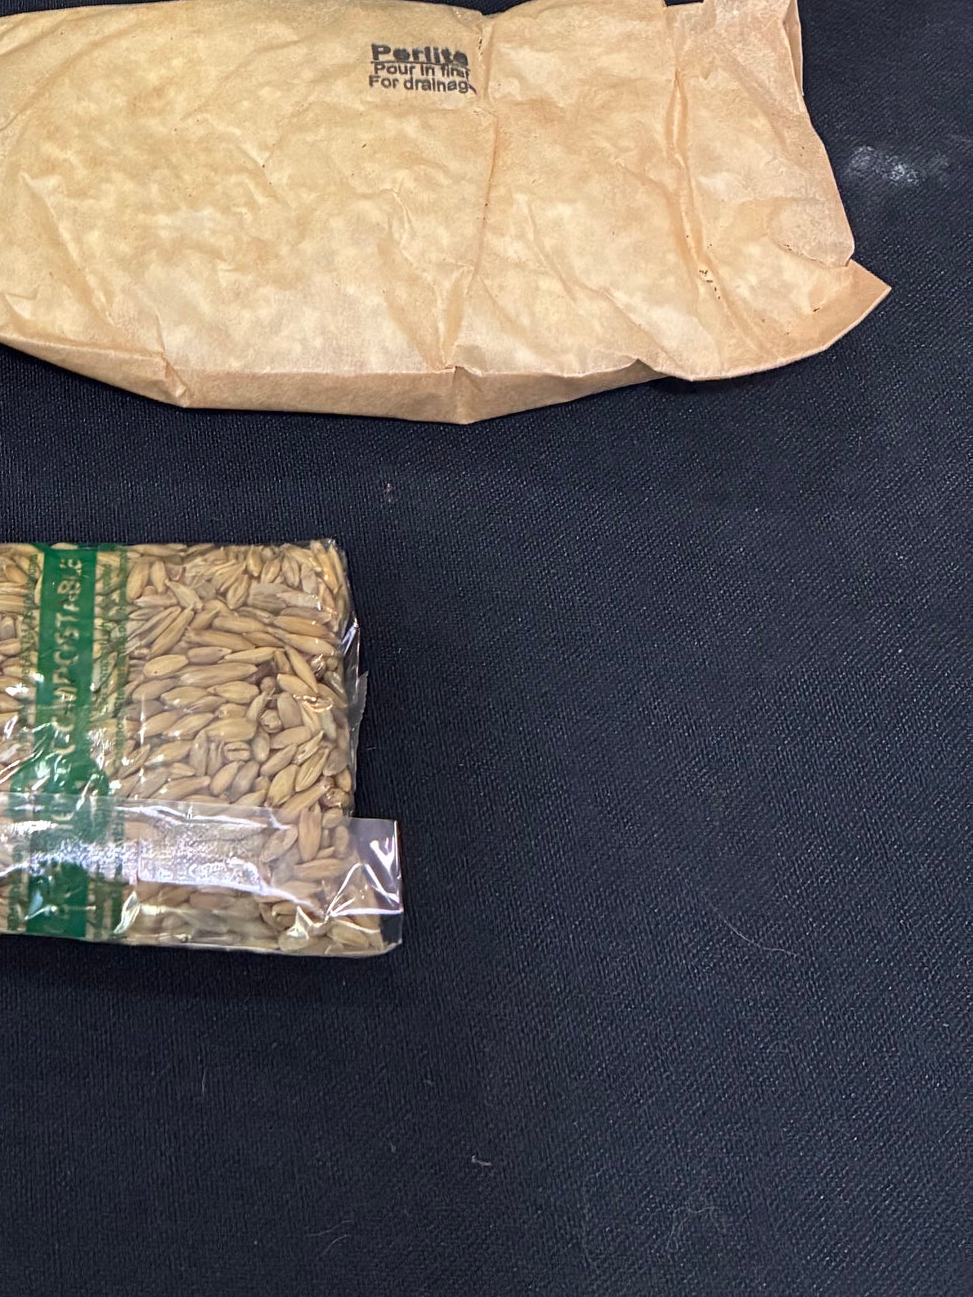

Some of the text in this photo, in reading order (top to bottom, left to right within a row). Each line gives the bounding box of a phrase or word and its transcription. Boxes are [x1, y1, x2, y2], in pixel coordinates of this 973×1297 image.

[370, 43, 469, 66] Perlite
[373, 62, 416, 75] Pour
[368, 75, 477, 95] For drainag
